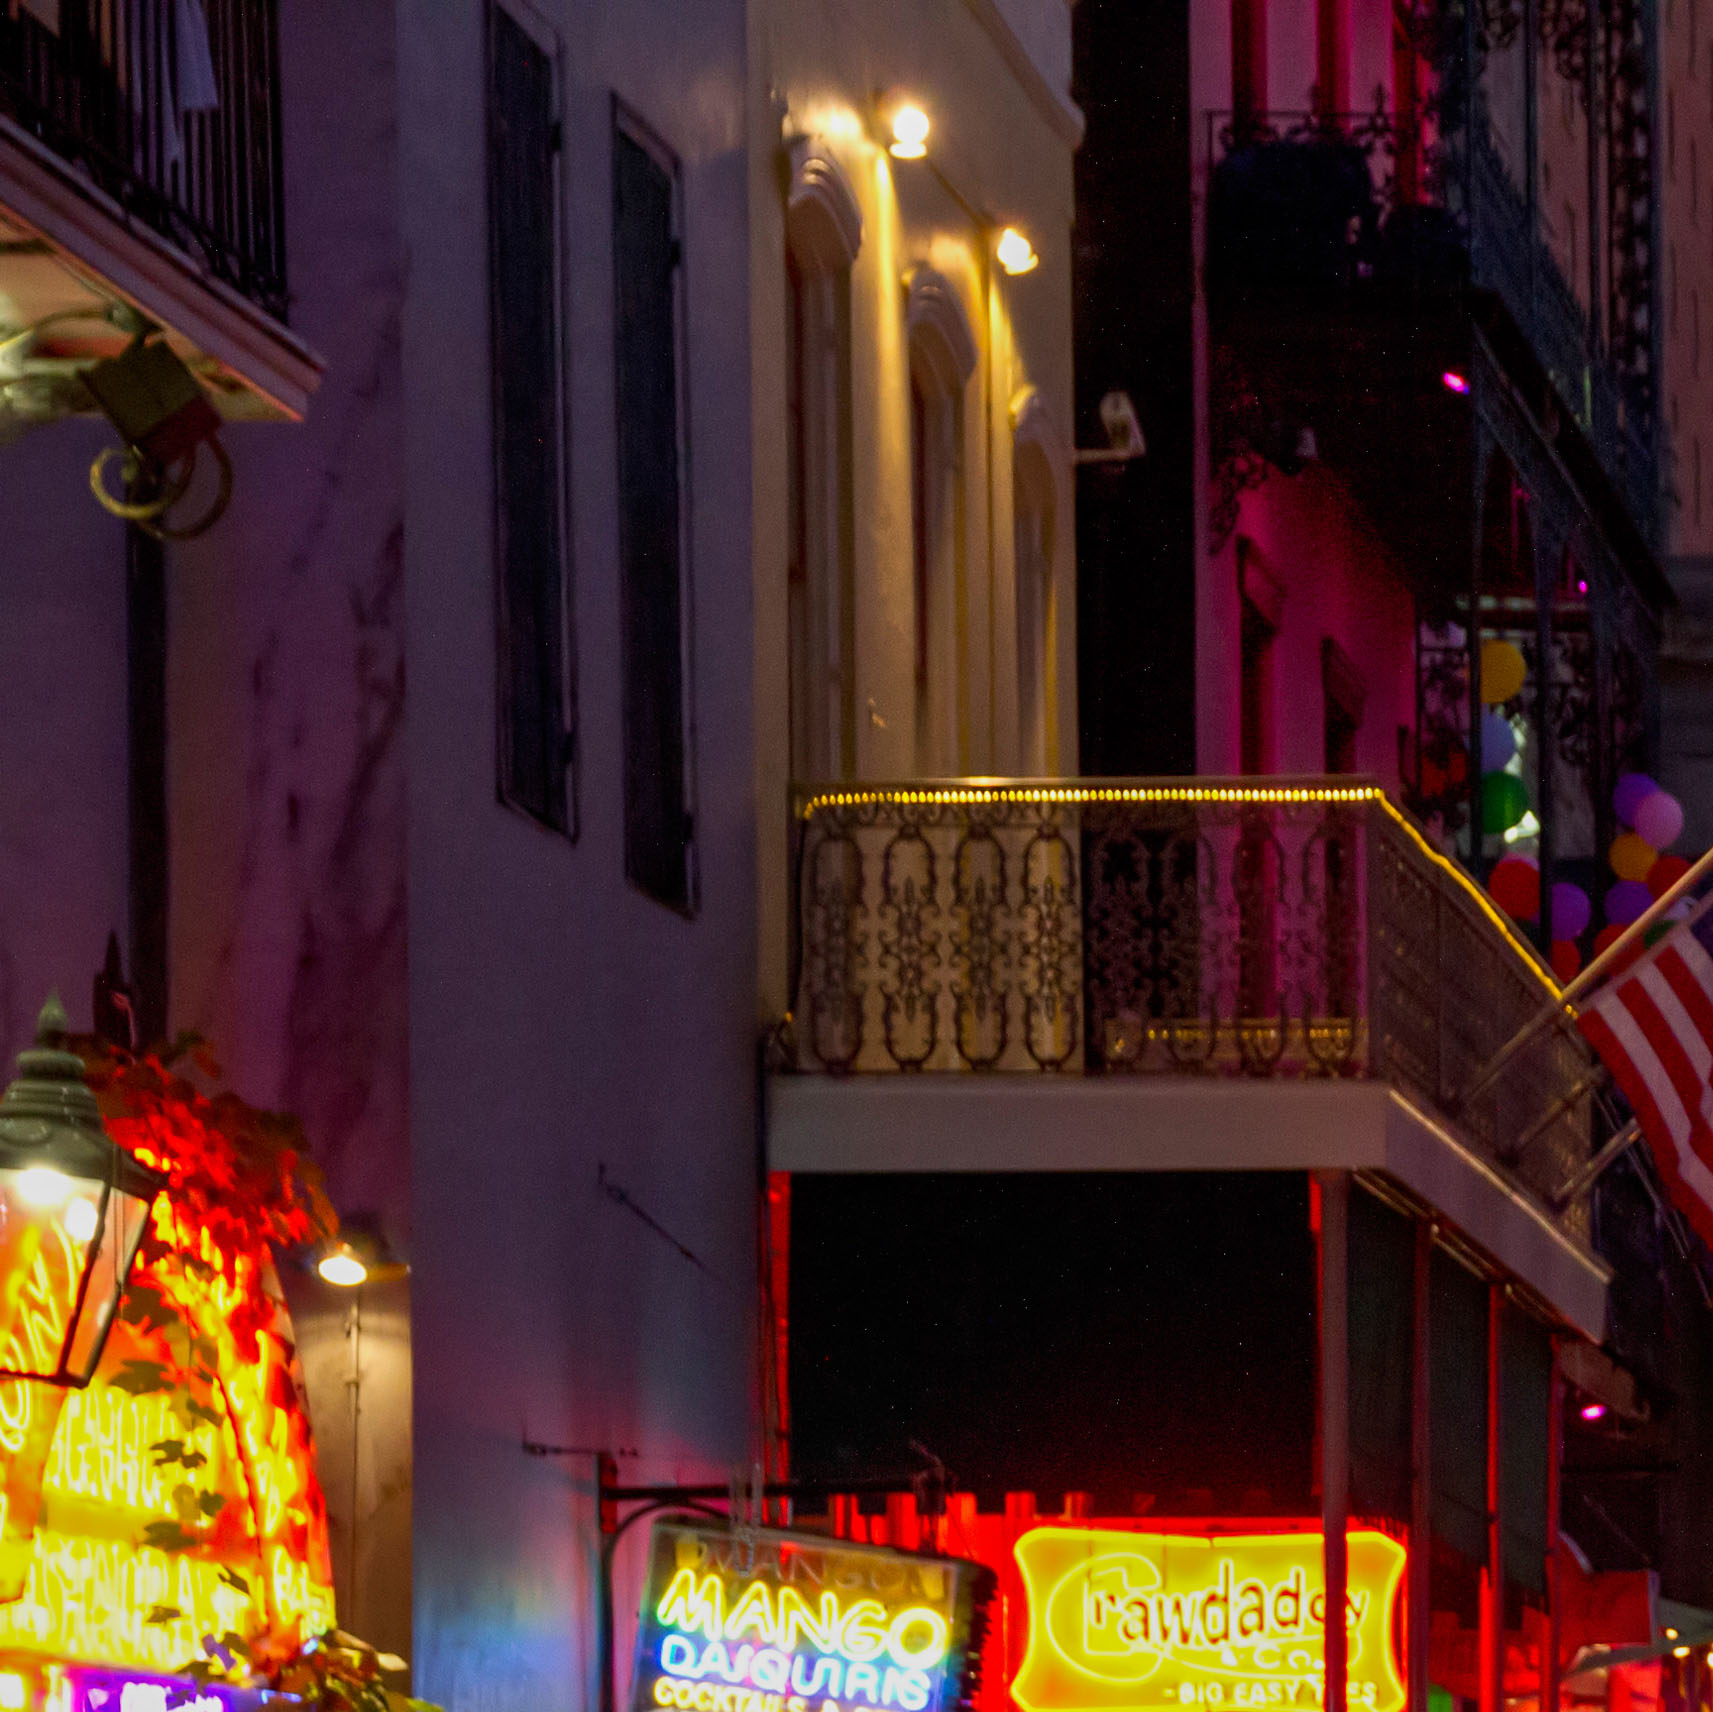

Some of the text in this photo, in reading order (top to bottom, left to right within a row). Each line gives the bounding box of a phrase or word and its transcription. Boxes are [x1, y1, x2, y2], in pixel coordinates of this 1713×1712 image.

[657, 1568, 948, 1671] MANGO
[661, 1634, 931, 1711] DAIQUIRIS
[1233, 1681, 1301, 1705] EASY
